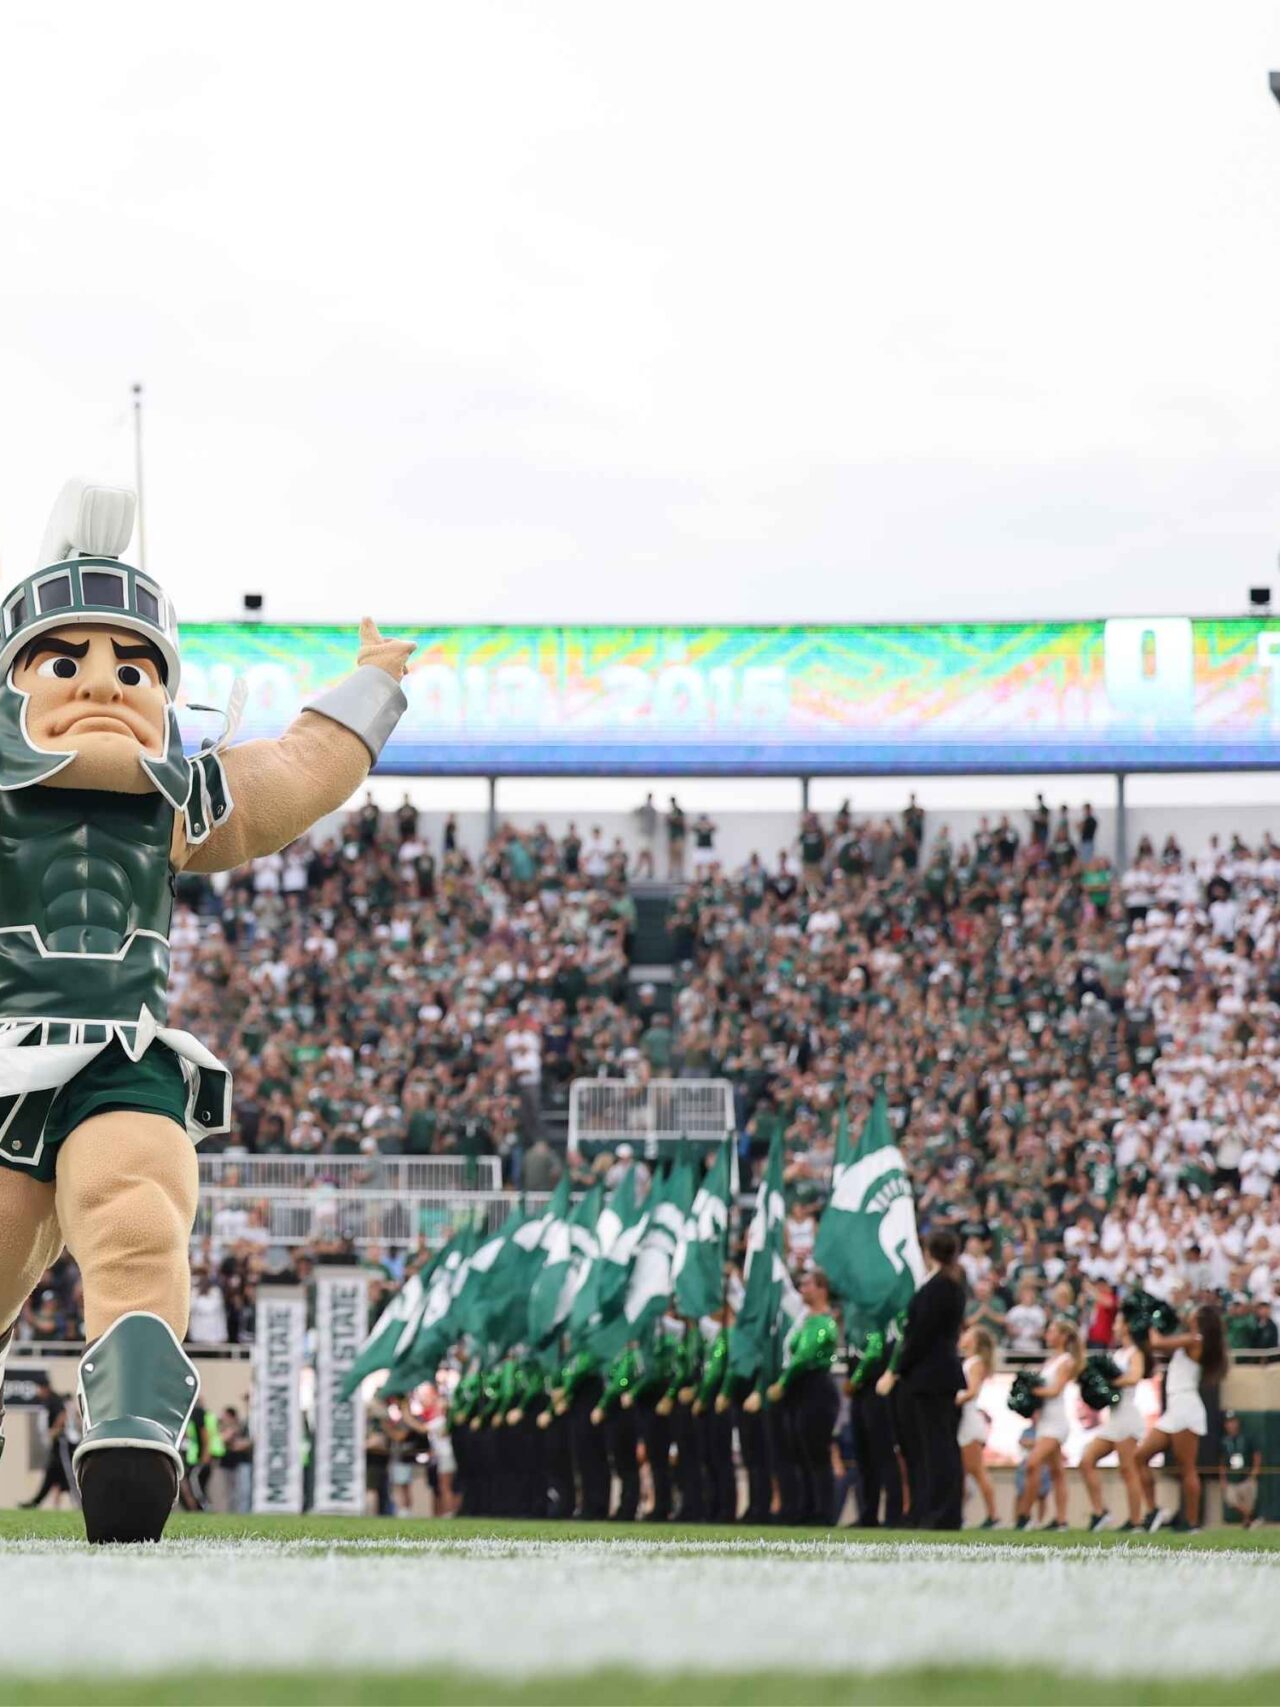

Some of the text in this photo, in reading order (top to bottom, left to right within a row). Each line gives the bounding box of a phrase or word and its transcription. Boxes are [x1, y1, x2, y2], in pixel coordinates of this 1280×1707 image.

[600, 665, 788, 729] 2015
[267, 1307, 291, 1375] STATE
[331, 1284, 357, 1360] STATE
